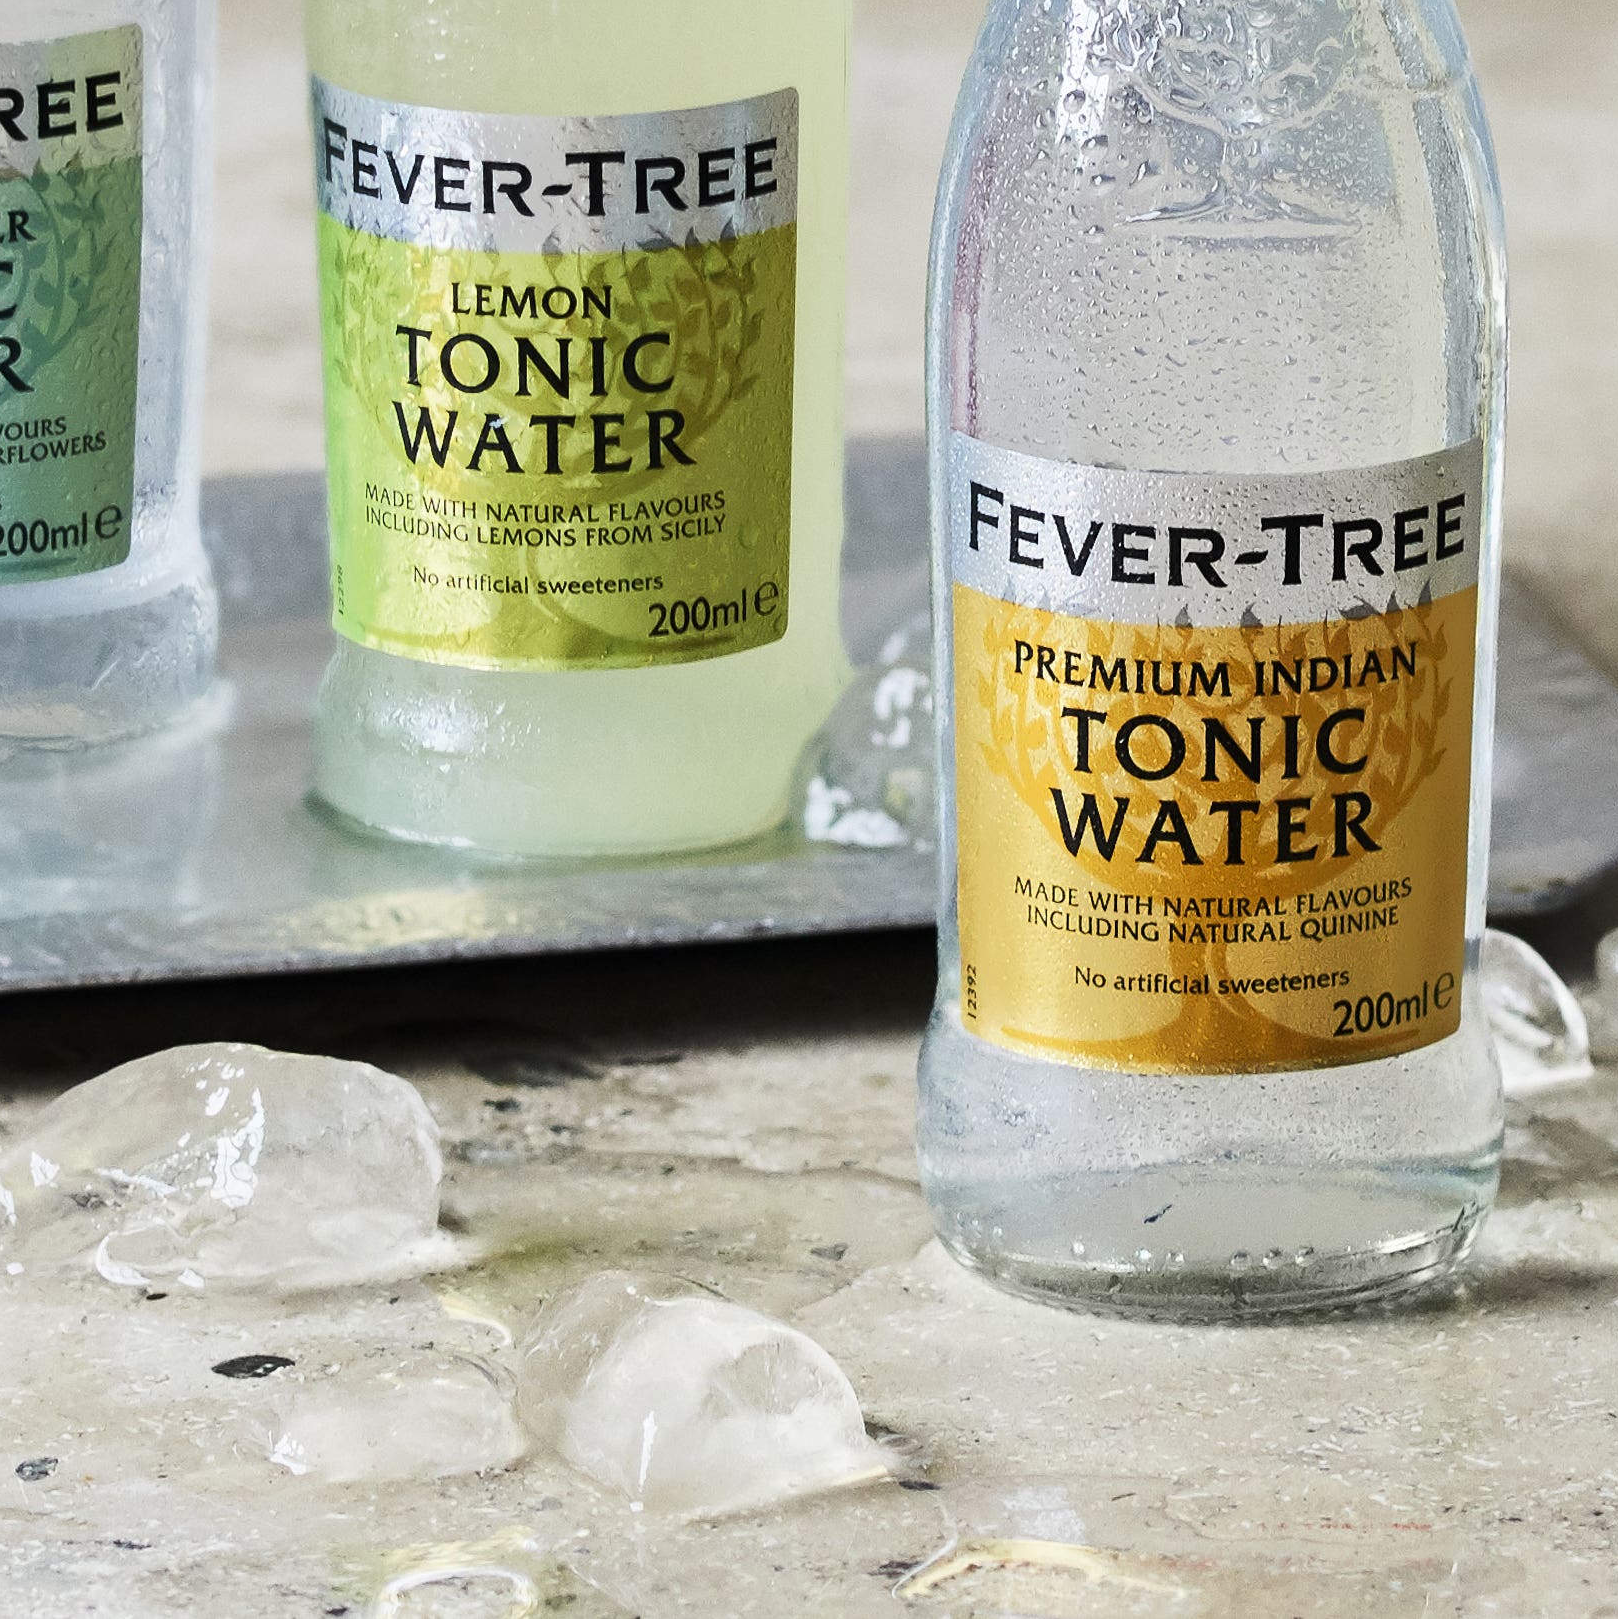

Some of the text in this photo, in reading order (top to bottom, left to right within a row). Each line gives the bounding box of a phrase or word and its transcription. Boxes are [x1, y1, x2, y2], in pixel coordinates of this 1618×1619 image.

[323, 118, 779, 217] FEVER-TREE
[451, 282, 612, 319] LEMON
[396, 325, 675, 398] TONIC
[392, 401, 698, 474] WATER
[365, 483, 726, 524] MADE WITH NATURAL FLAVOURS
[365, 506, 727, 547] INCLUDING LEMONS FROM SICILY
[968, 481, 1466, 588] FEVER-TREE
[413, 566, 664, 595] No artificial sweeteners
[649, 588, 747, 637] 200ml
[1014, 640, 1417, 697] PREMIUM INDIAN
[1060, 706, 1368, 783] TONIC
[1049, 786, 1382, 865] WATER
[1015, 875, 1412, 918] MADE WITH NATURAL FLAVOURS
[1027, 904, 1399, 943] INCLUDING NATURAL QUININE
[967, 965, 977, 1019] 12392
[1074, 967, 1350, 995] No artificial sweeteners
[1332, 994, 1429, 1038] 200ml
